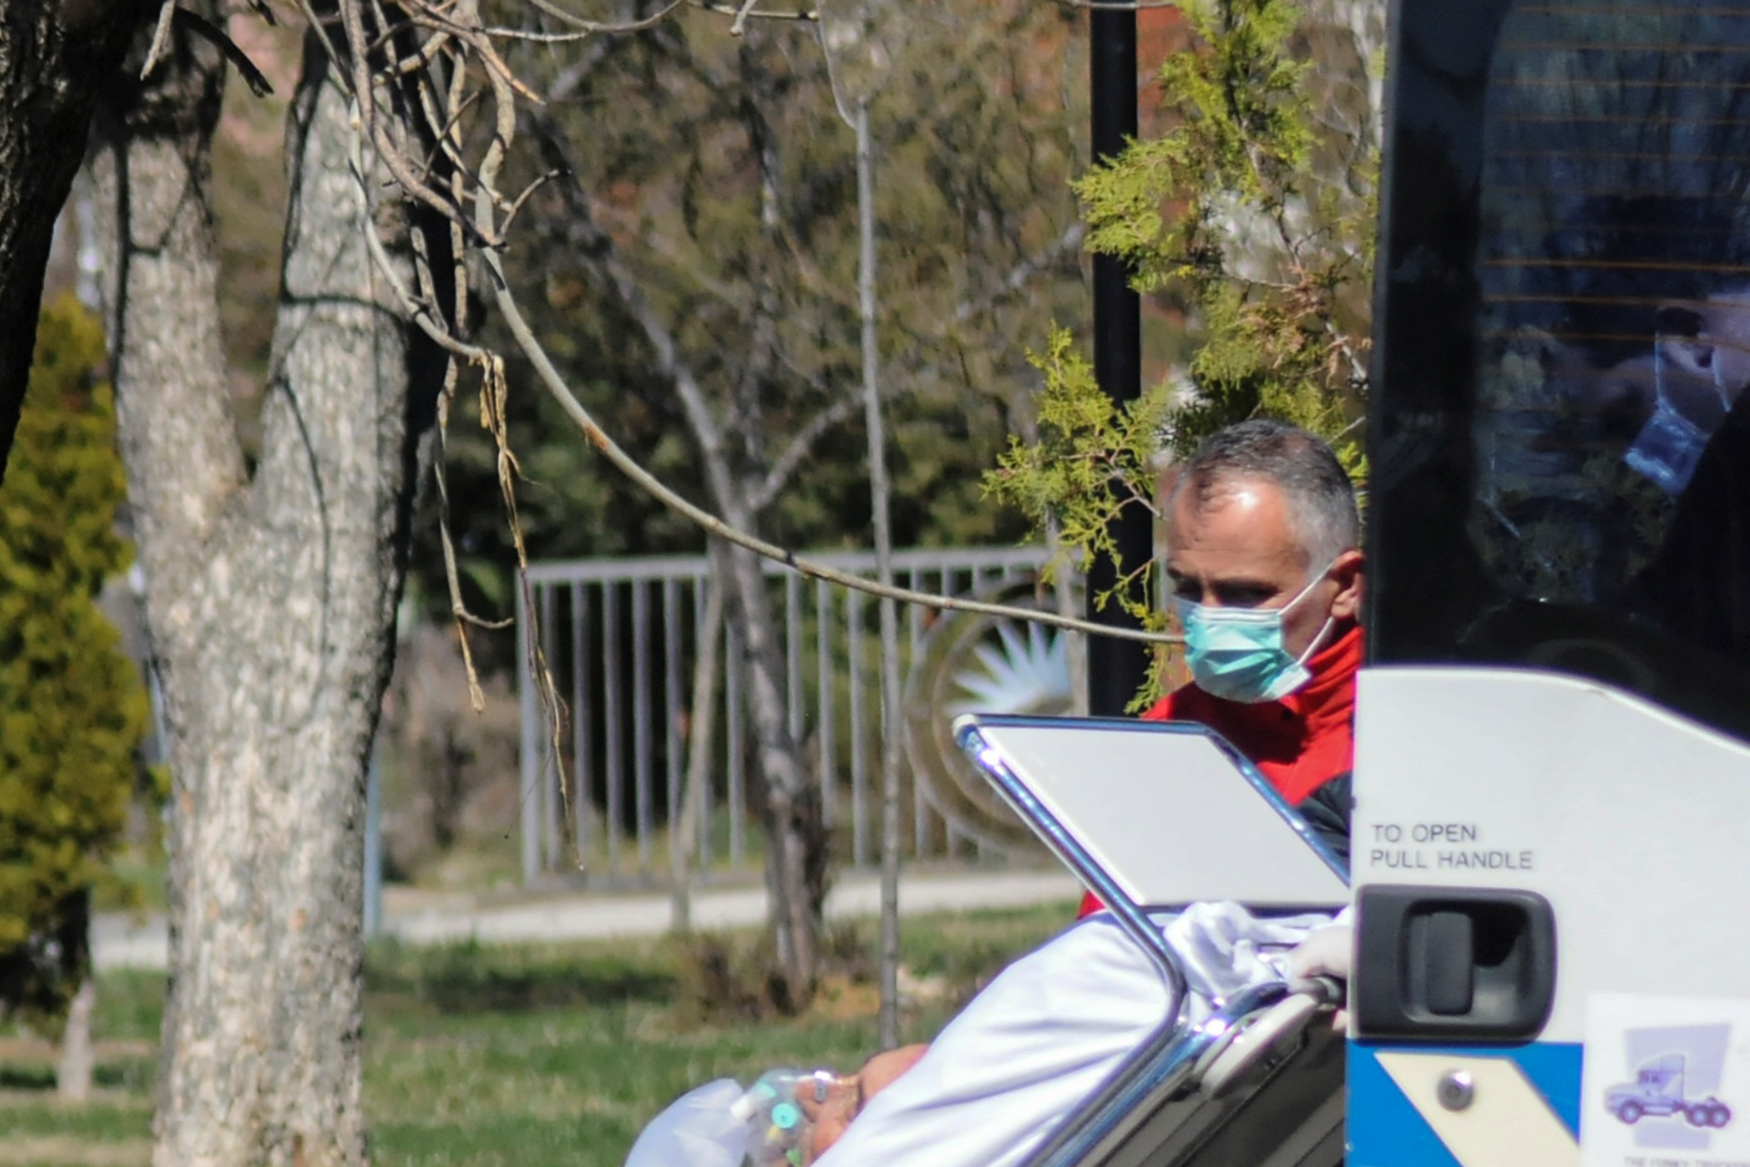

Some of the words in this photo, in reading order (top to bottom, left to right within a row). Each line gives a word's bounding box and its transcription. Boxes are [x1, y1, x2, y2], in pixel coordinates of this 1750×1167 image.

[1371, 823, 1402, 843] TO
[1411, 823, 1477, 843] OPEN
[1369, 849, 1428, 869] PULL
[1437, 850, 1534, 870] HANDLE
